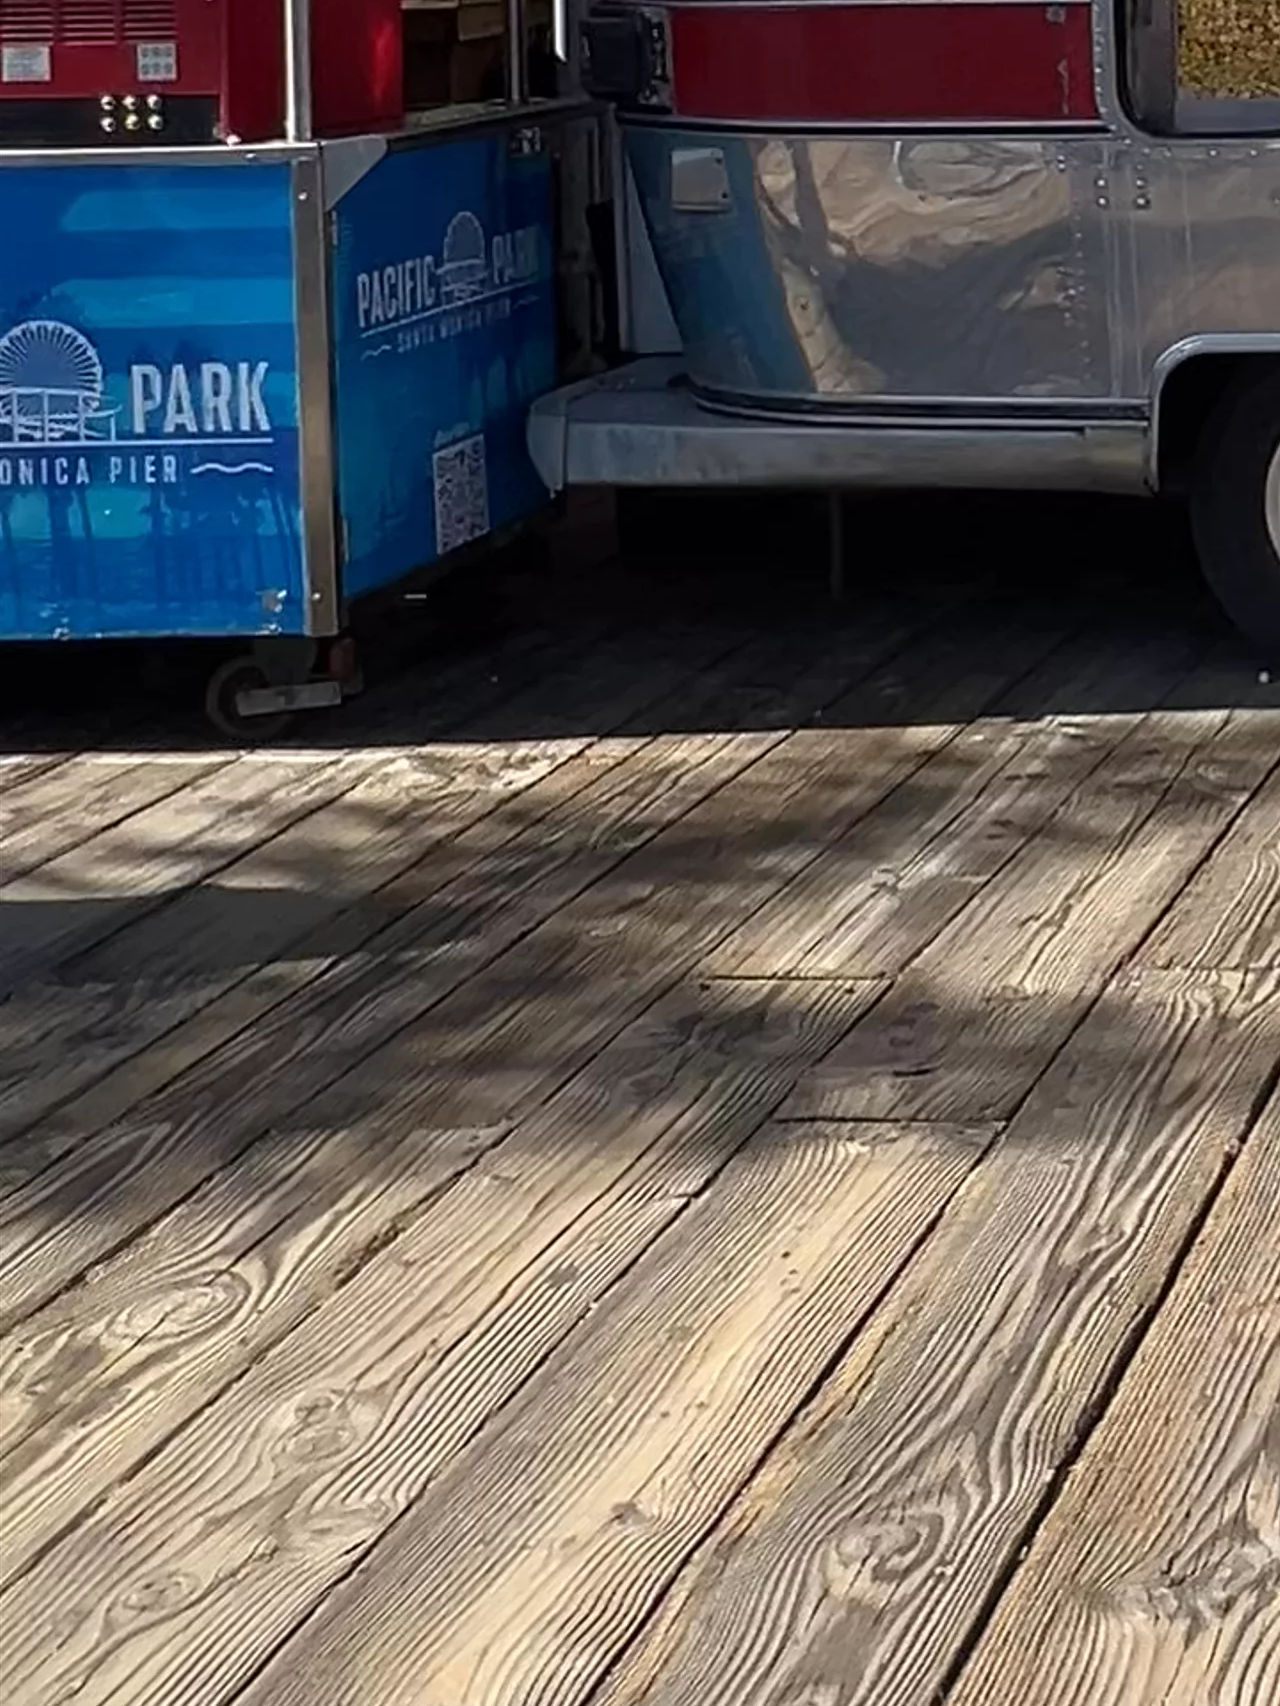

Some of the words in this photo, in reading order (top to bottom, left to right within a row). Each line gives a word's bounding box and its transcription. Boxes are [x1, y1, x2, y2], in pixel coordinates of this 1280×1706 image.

[357, 255, 436, 328] PACIFIC
[130, 361, 271, 434] PARK
[109, 454, 177, 484] PIER
